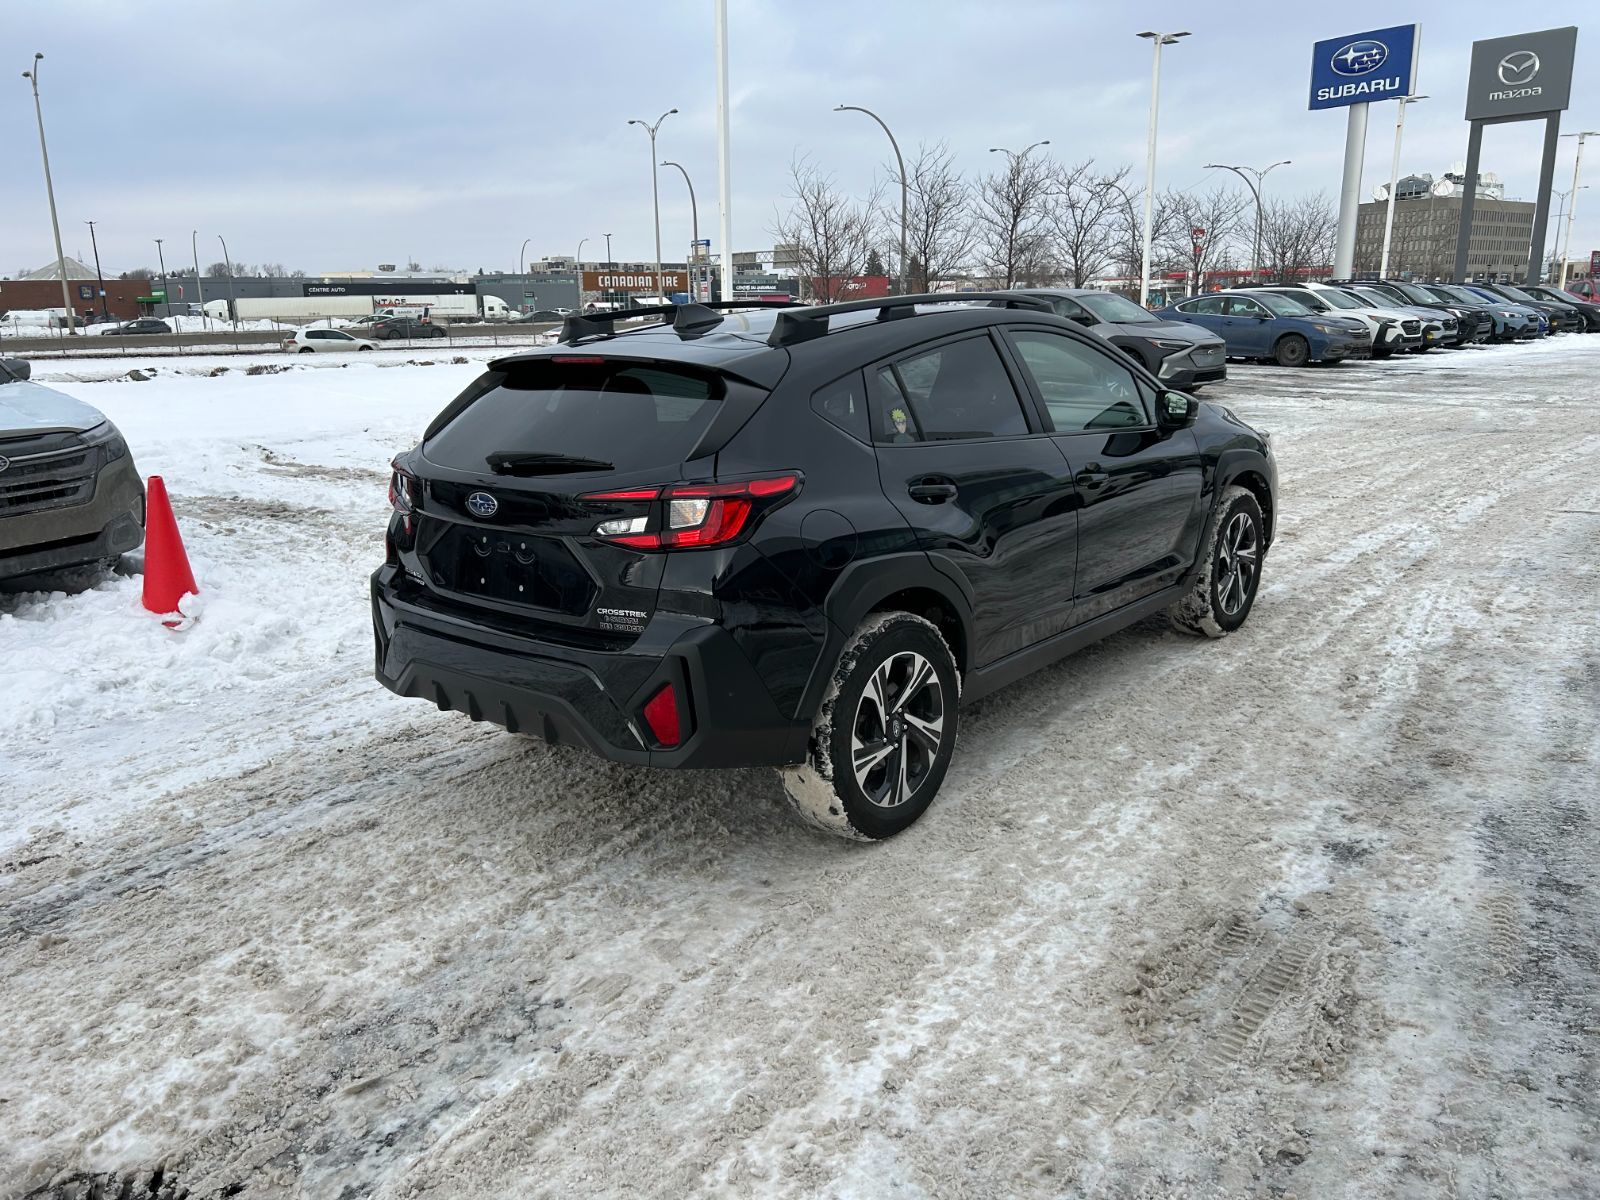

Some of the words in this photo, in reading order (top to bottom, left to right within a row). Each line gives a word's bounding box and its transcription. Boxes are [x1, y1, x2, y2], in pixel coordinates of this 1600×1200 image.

[1317, 77, 1400, 101] SUBARU
[1489, 86, 1542, 101] mazda
[598, 275, 652, 287] CANADIAN
[597, 607, 648, 618] CROSSTREK
